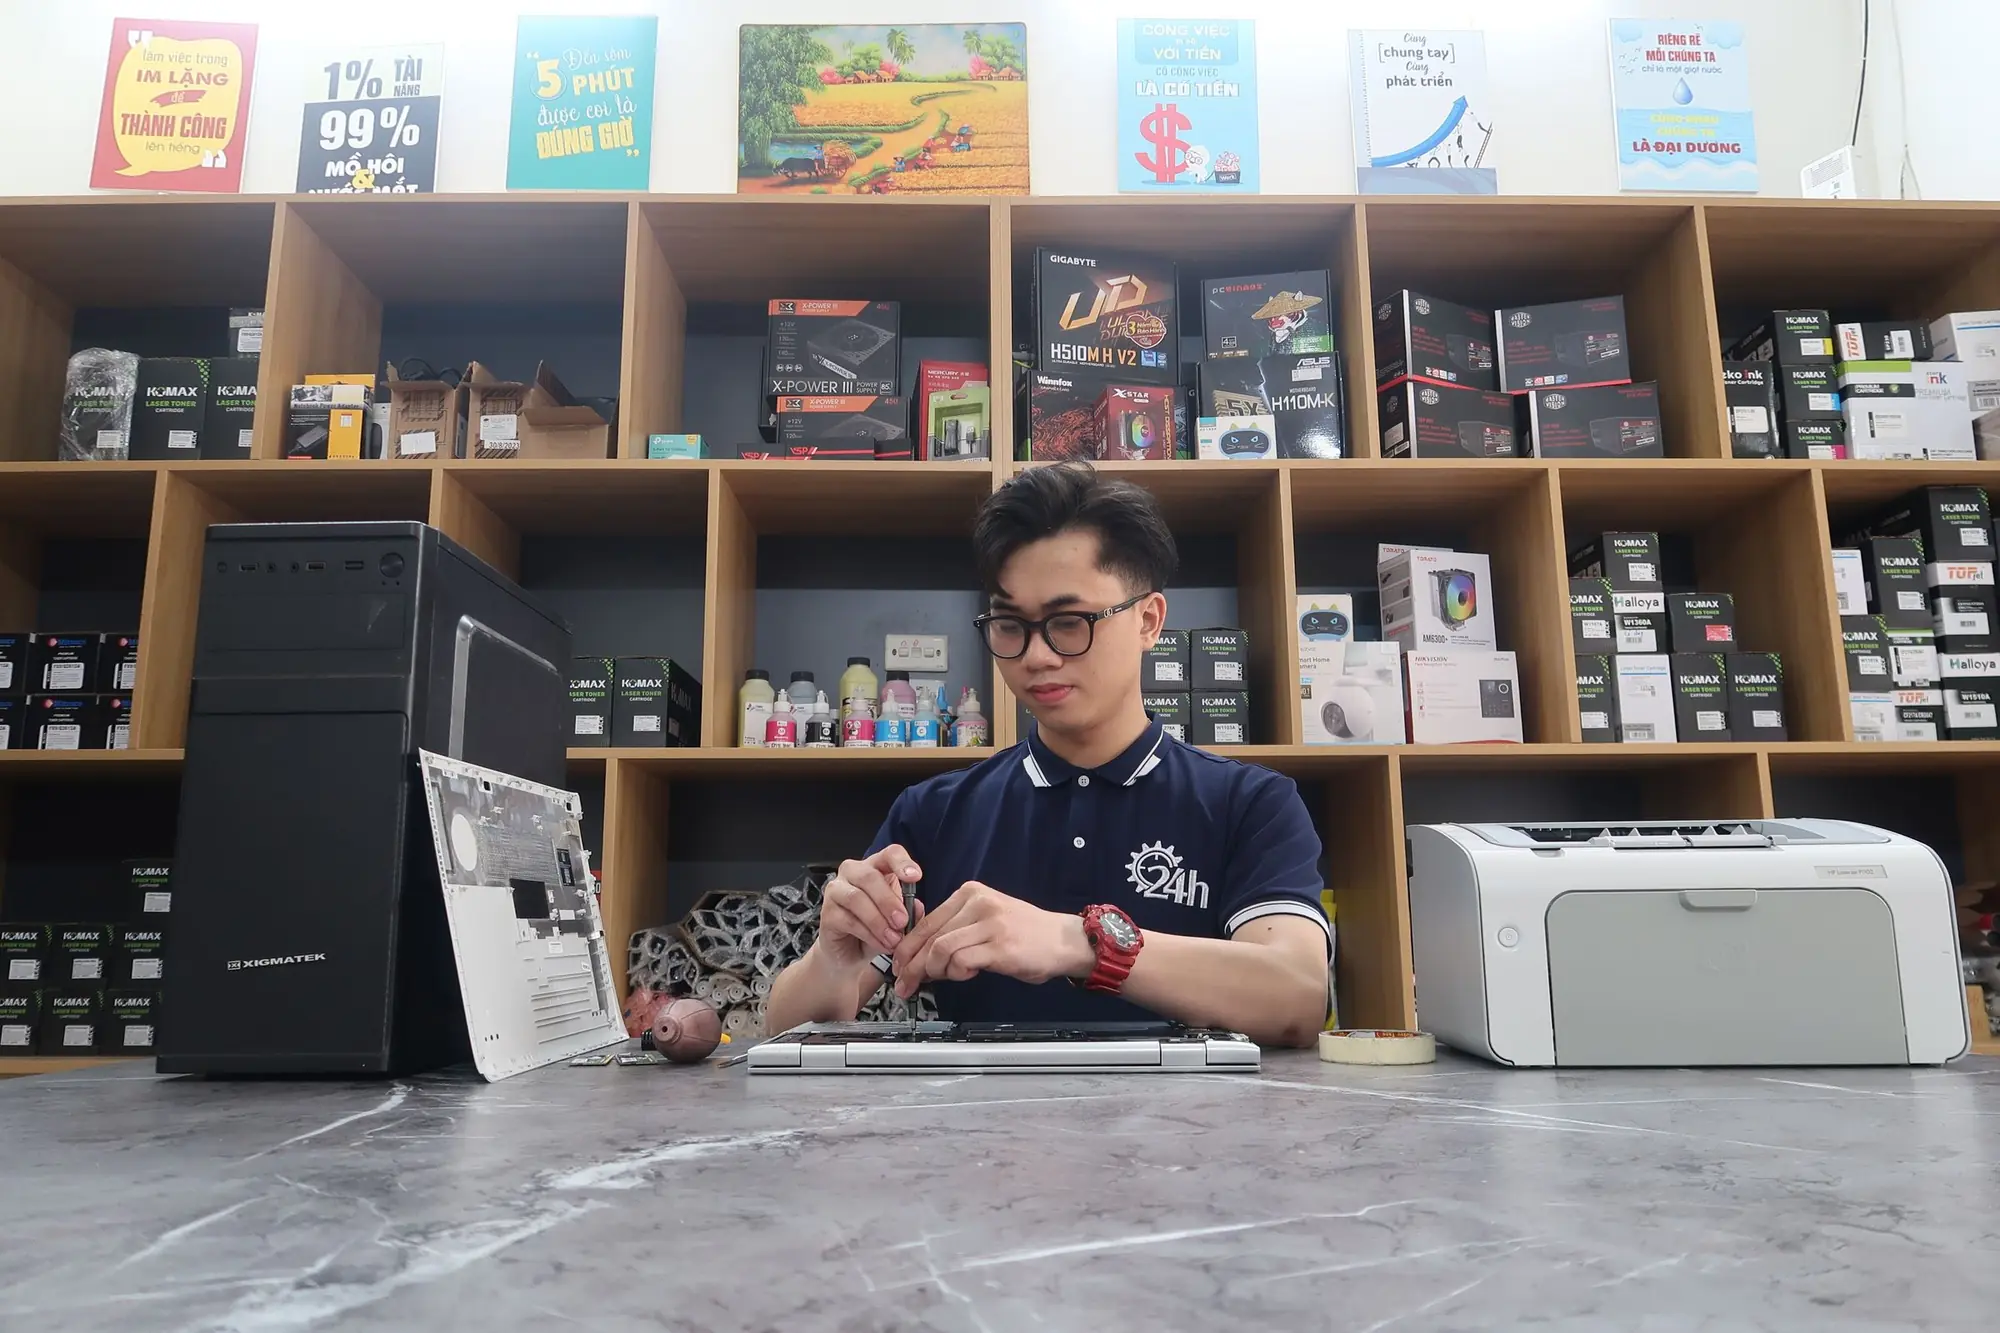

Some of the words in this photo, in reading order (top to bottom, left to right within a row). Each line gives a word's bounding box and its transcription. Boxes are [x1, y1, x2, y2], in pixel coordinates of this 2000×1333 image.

[1657, 32, 1687, 46] RIÊNG
[196, 53, 228, 67] trong
[1645, 47, 1666, 61] MỖI
[1668, 48, 1702, 62] CHÚNG
[1704, 51, 1717, 63] TA
[394, 55, 422, 82] TÀI
[136, 69, 161, 83] IM
[169, 67, 228, 88] LẶNG
[324, 58, 383, 100] 1%
[536, 58, 562, 98] 5
[572, 64, 635, 96] PHÚT
[1385, 75, 1417, 89] phát
[1420, 71, 1453, 87] triển
[1135, 79, 1160, 97] LÀ
[1163, 80, 1192, 97] CÓ
[537, 104, 580, 126] được
[586, 101, 611, 119] coi
[615, 93, 637, 115] là
[120, 110, 176, 137] THÀNH
[180, 113, 228, 139] CÔNG
[320, 105, 420, 151] 99%
[536, 125, 595, 160] ĐÚNG
[598, 115, 634, 150] GIỜ
[1632, 138, 1651, 152] LÀ
[1653, 141, 1682, 156] ĐẠI
[1685, 141, 1742, 154] DƯƠNG
[367, 153, 405, 174] HÔI
[352, 168, 375, 190] &
[1050, 254, 1097, 267] GIGABYTE
[1785, 316, 1819, 324] KOMAX
[1128, 320, 1136, 335] 3
[1050, 343, 1099, 363] H510M
[1102, 347, 1113, 364] H
[1117, 349, 1137, 366] V2
[1297, 356, 1331, 366] ASUS
[1037, 375, 1073, 387] Winnfox
[1792, 371, 1826, 379] KOMAX
[147, 386, 198, 397] KOMAX
[217, 385, 257, 396] KOMA
[772, 380, 838, 393] X-POWER
[842, 381, 853, 394] III
[1112, 388, 1149, 398] X-STAR
[1271, 393, 1335, 412] H110M-K
[1797, 426, 1831, 434] KOMAX
[1940, 503, 1980, 512] KOMAX
[1614, 539, 1648, 547] KOMAX
[1881, 557, 1919, 566] KOMAX
[1614, 596, 1660, 610] Halloya
[1685, 600, 1719, 608] KOMAX
[1202, 636, 1237, 645] KOMAX
[1949, 658, 1997, 672] Halloya
[621, 679, 662, 688] KOMAX
[1680, 675, 1720, 684] KOMAX
[1735, 675, 1777, 684] KOMAX
[1144, 698, 1179, 706] KOMAX
[1202, 698, 1237, 706] KOMAX
[132, 867, 169, 876] KOMAX
[1143, 865, 1210, 909] 24h
[1, 932, 39, 941] KOMAX
[62, 932, 101, 941] KOMAX
[124, 932, 162, 941] KOMAX
[243, 952, 326, 968] XIGMATEK
[53, 998, 91, 1007] KOMAX
[114, 998, 151, 1007] KOMAX
